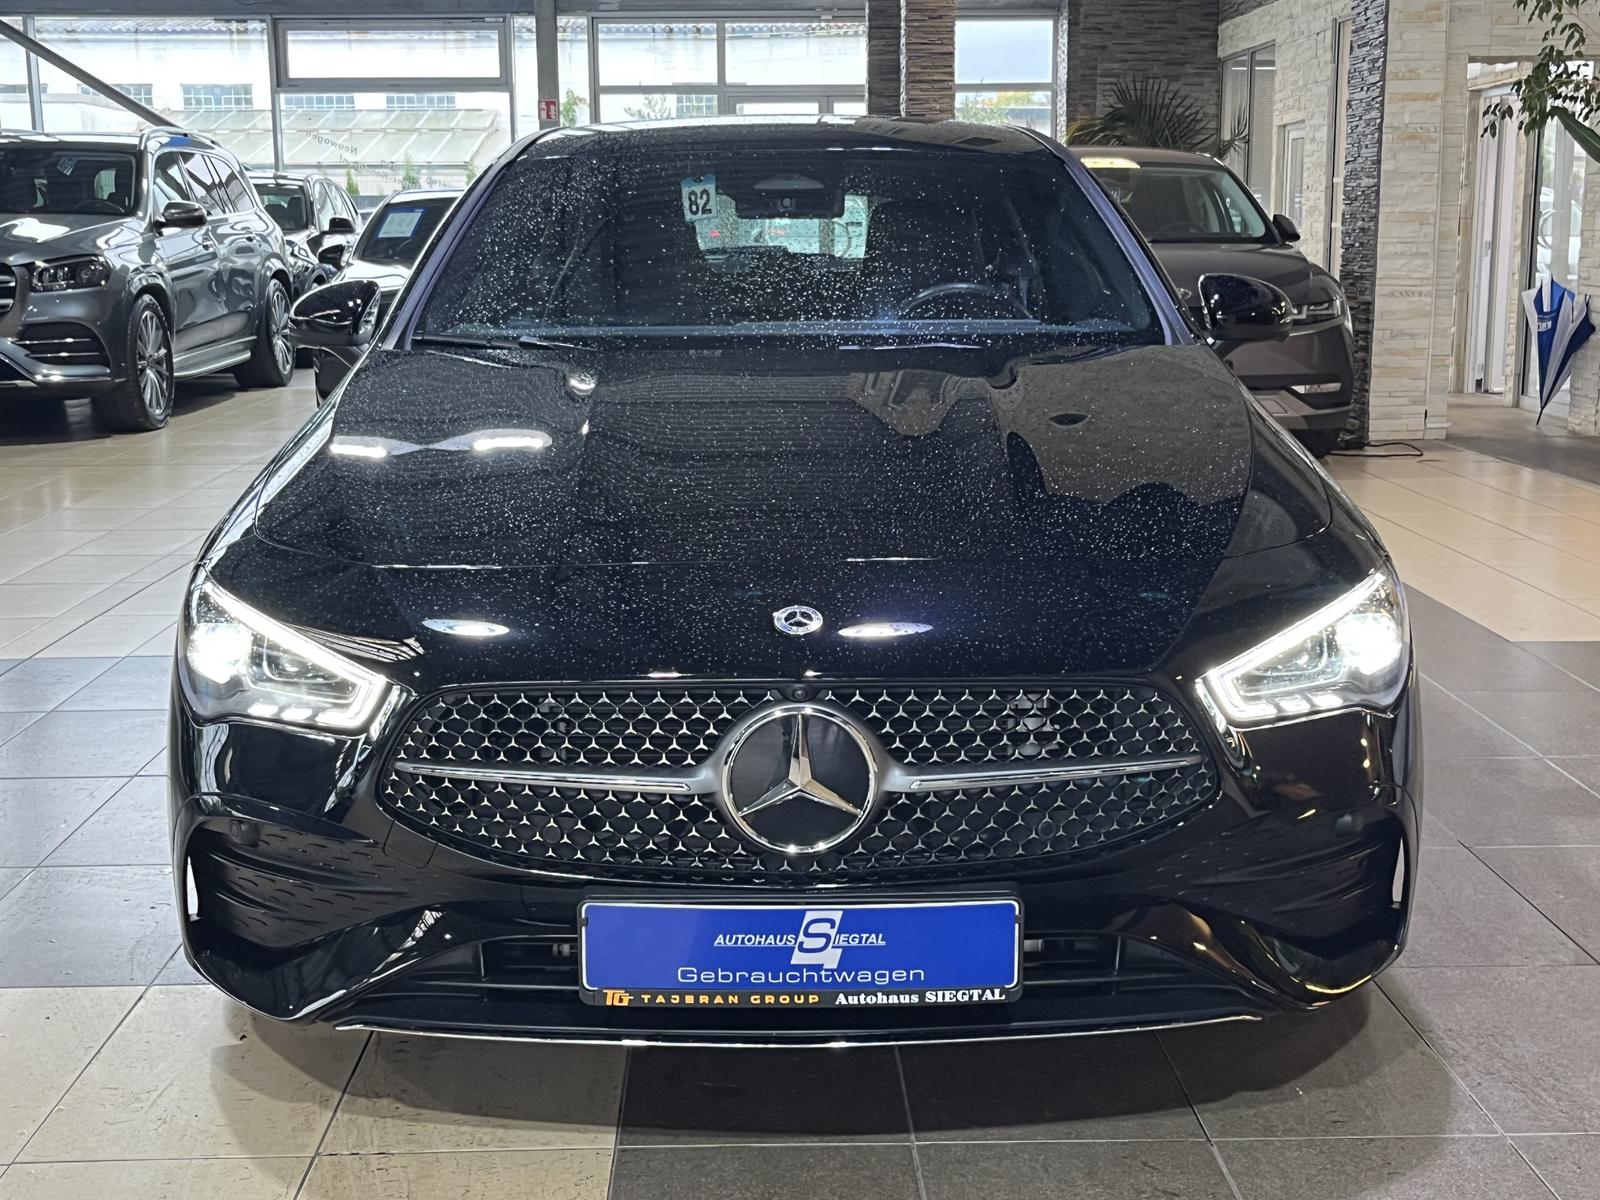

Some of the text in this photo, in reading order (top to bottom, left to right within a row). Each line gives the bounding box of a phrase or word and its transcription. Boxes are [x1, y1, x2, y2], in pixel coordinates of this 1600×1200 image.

[688, 189, 712, 216] 82
[714, 934, 797, 946] AUTOHAUS
[677, 967, 925, 985] Gebrauchtwagen
[603, 989, 634, 1006] TG
[750, 994, 820, 1004] GROUP
[835, 988, 1006, 1005] Autohaus SIEGTAL
